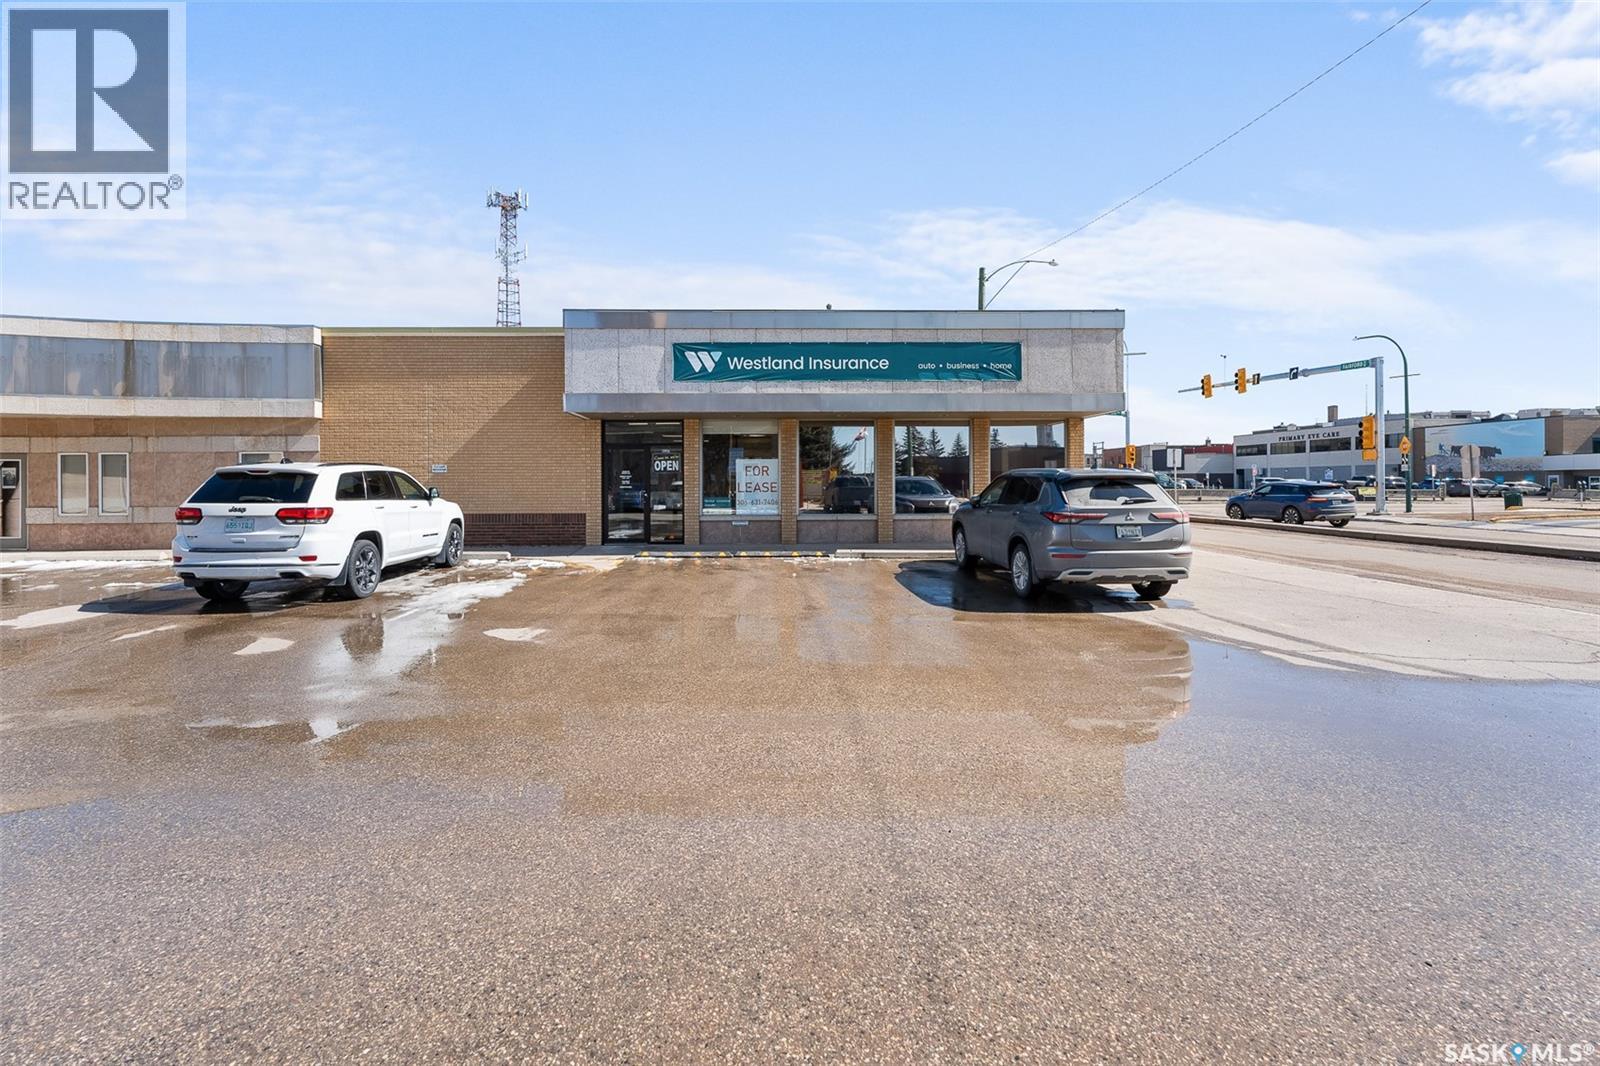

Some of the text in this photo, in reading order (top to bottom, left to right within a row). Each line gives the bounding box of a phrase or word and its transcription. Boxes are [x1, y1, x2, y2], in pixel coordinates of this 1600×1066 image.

[727, 355, 889, 371] Westland Insurance
[917, 361, 1013, 370] auto business home
[1278, 434, 1305, 442] PRIMARY
[654, 460, 679, 471] OPEN
[745, 465, 770, 476] FOR
[737, 481, 778, 493] LEASE
[228, 506, 247, 514] Jeep
